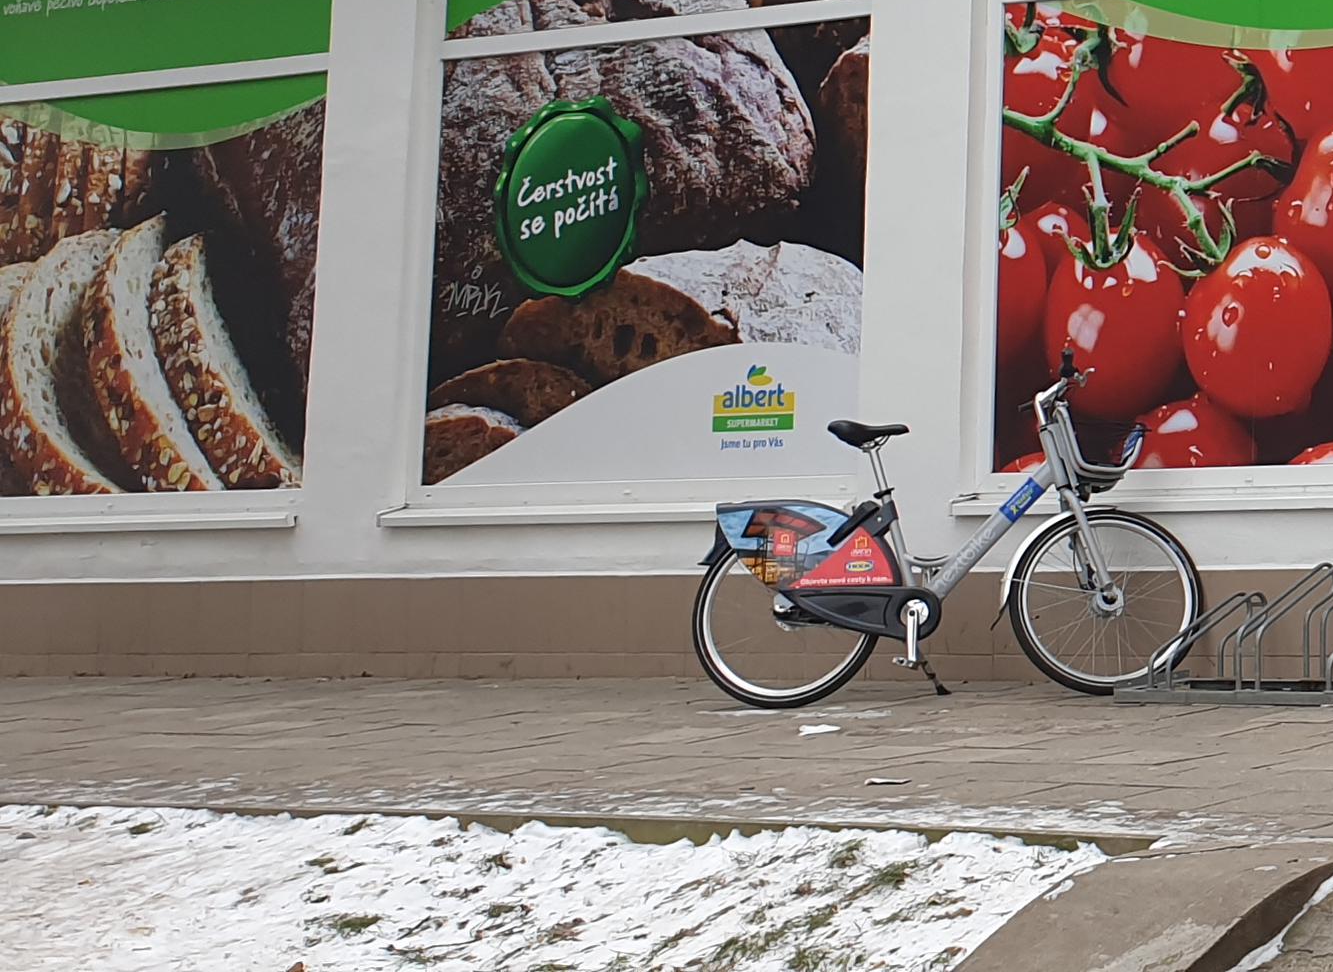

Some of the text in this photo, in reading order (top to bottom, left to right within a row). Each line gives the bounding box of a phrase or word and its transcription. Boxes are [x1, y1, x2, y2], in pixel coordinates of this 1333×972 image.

[517, 157, 619, 208] Čerstvost
[520, 189, 620, 240] se počítá
[721, 383, 786, 410] albert
[726, 417, 779, 429] SUPERMARKET
[720, 436, 784, 450] Jsme tu pro Vás
[936, 528, 996, 589] nextbike
